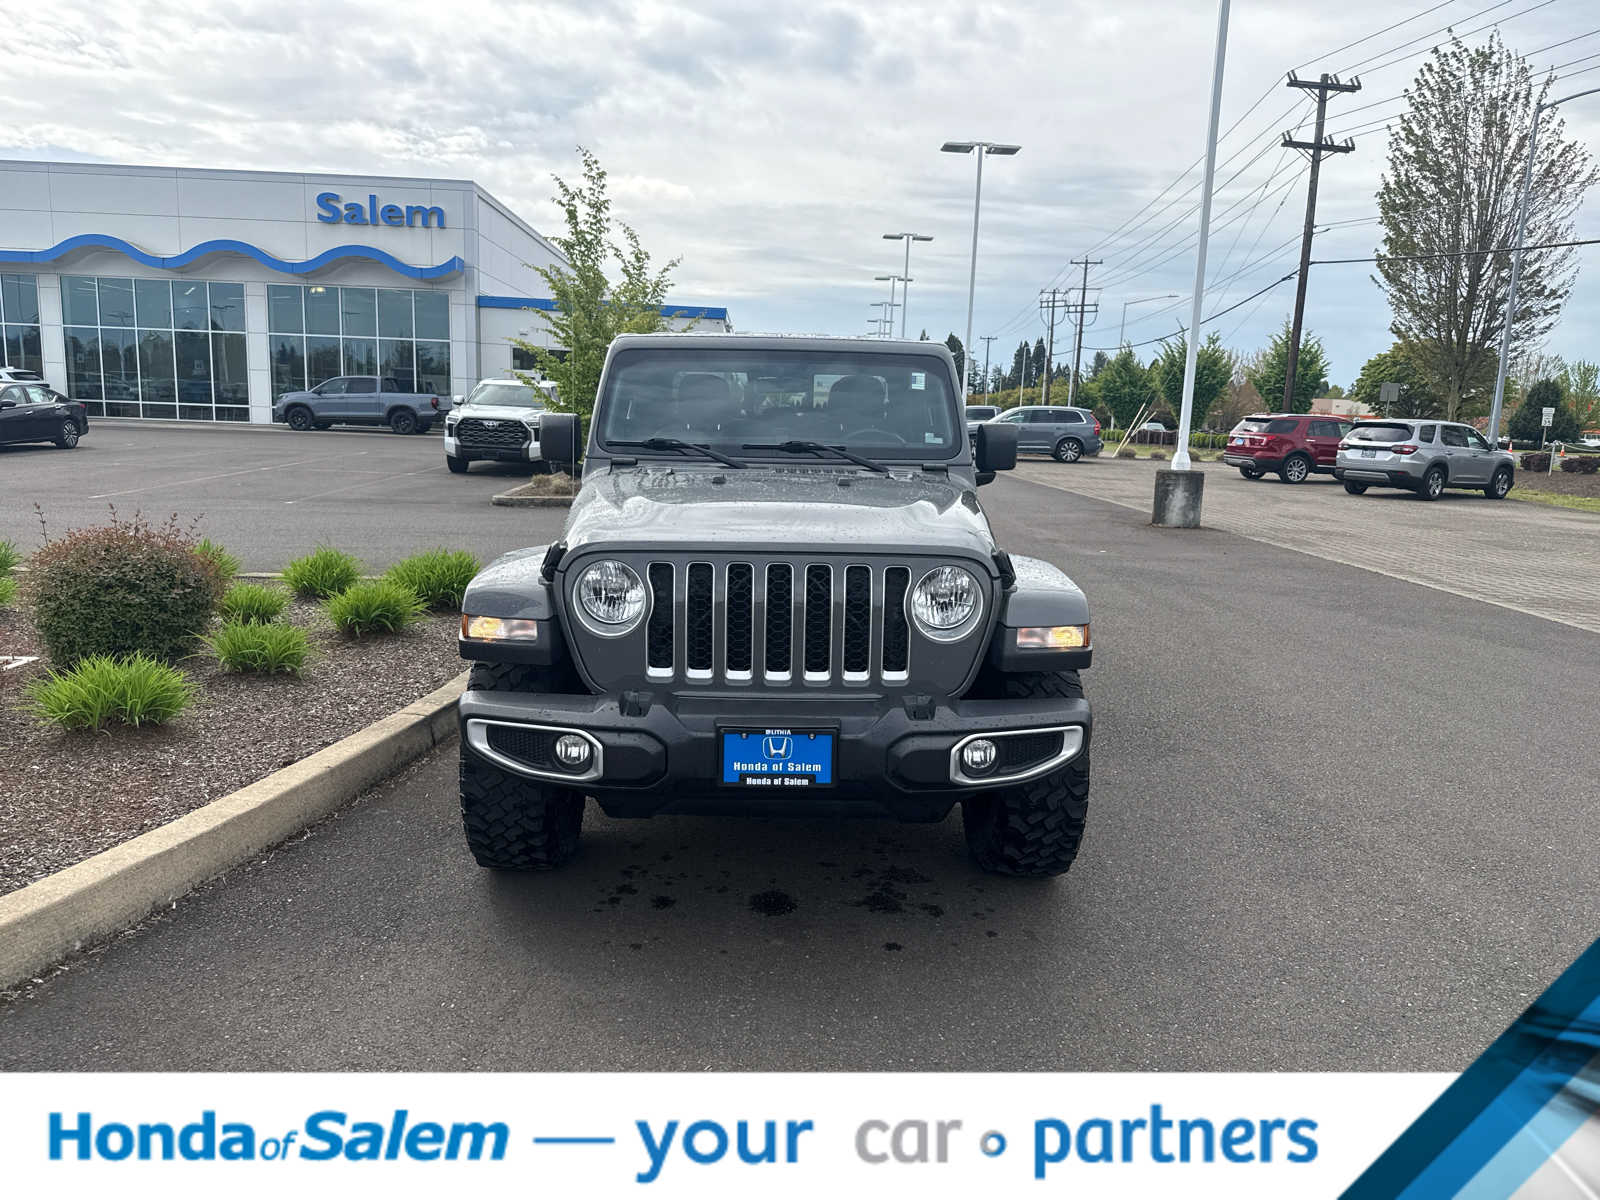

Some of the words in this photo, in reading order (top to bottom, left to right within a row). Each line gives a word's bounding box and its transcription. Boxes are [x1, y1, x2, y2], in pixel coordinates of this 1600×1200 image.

[316, 191, 446, 229] Salem
[733, 762, 768, 771] Honda
[772, 762, 783, 771] of
[787, 762, 822, 772] Salem
[746, 777, 771, 785] Honda
[773, 777, 782, 785] of
[784, 777, 809, 786] Salem
